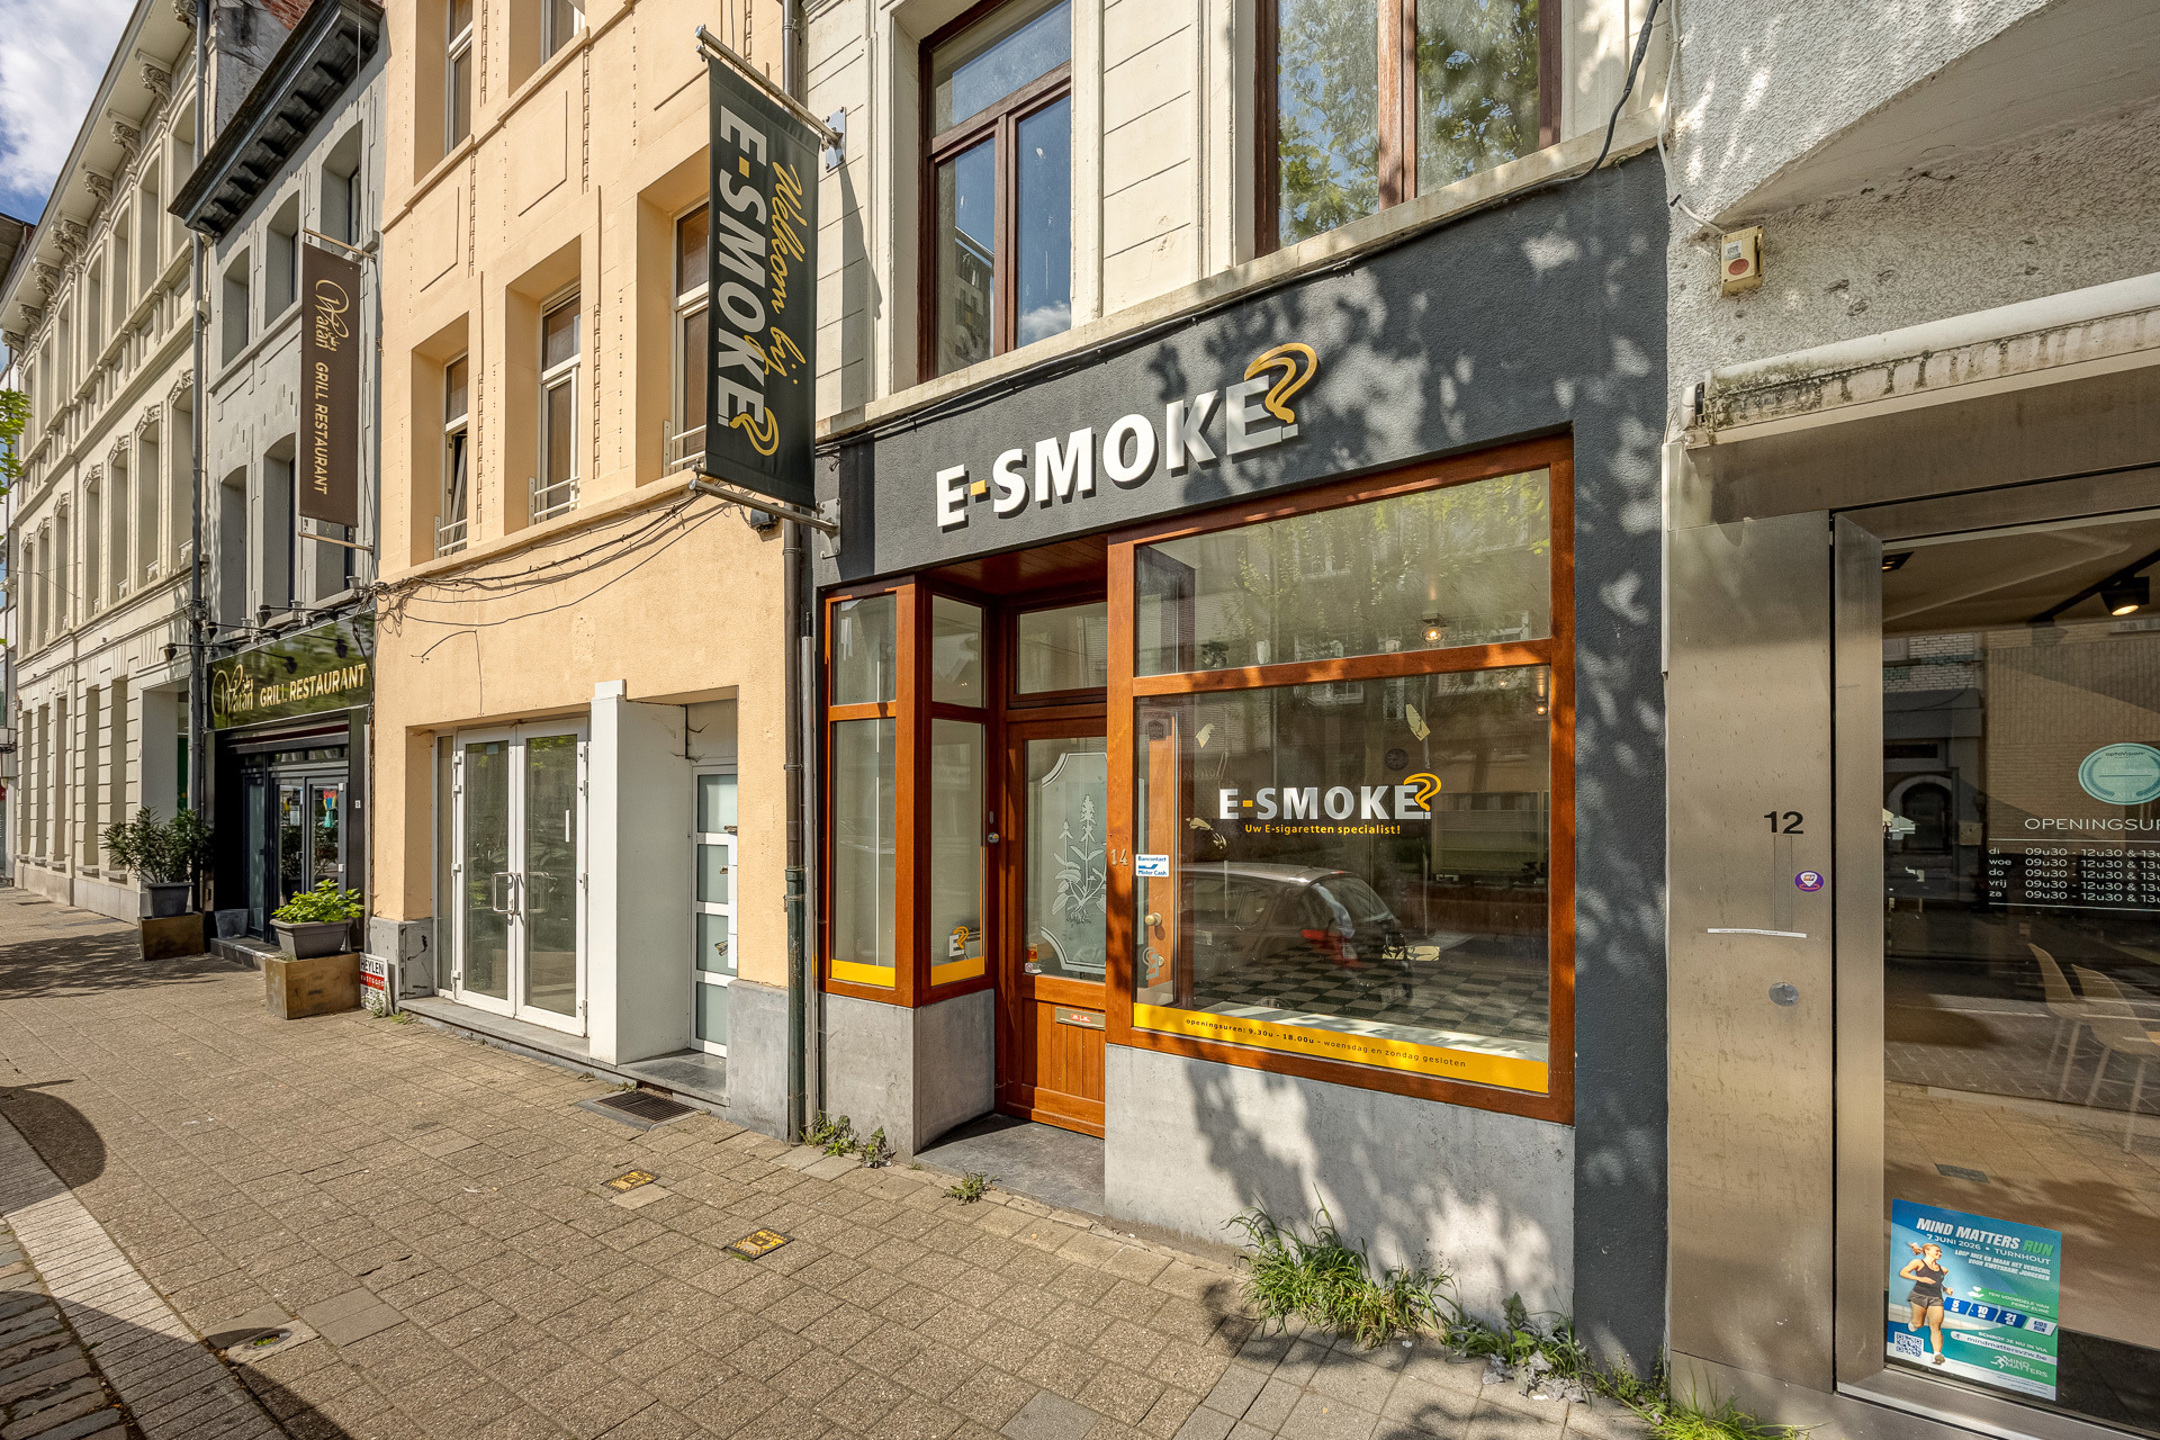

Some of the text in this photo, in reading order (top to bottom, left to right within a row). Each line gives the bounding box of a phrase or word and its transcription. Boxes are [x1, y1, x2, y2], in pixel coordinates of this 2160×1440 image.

[744, 162, 808, 384] Welkom bij
[314, 362, 329, 494] GRILL RESTAURANT
[260, 663, 367, 708] GRILL RESTAURANT
[1764, 811, 1804, 834] 12
[2025, 818, 2160, 830] OPENINGSU
[1245, 824, 1401, 836] Uw E-sigaretten specialist!
[1111, 849, 1128, 866] 14
[2025, 848, 2068, 856] 09u30
[2127, 850, 2137, 858] &
[2025, 858, 2068, 866] 09u30
[2080, 860, 2123, 868] 12u30
[2127, 861, 2137, 869] &
[2025, 869, 2068, 878] 09u30
[2080, 871, 2123, 879] 12u30
[2127, 872, 2137, 880] &
[1989, 879, 2007, 888] vrij
[2025, 880, 2068, 888] 09u30
[2080, 882, 2123, 890] 12u30
[2127, 883, 2137, 891] &
[2025, 890, 2068, 899] 09u30
[2080, 893, 2123, 901] 12u30
[2127, 894, 2137, 902] &
[360, 958, 384, 976] HEYLEN
[1186, 1018, 1247, 1034] openingsuren:
[1248, 1028, 1273, 1038] 9.30u
[1283, 1033, 1314, 1044] 18.00u
[1324, 1040, 1368, 1054] woensdag
[1385, 1050, 1419, 1062] zondag
[1422, 1054, 1466, 1068] gesloten
[1916, 1218, 2054, 1256] MIND MATTERS RUN
[1934, 1235, 1956, 1244] JUNI
[1958, 1240, 1981, 1250] 2026
[1994, 1248, 2051, 1265] TURNHOUT
[1978, 1306, 1989, 1314] 10
[2005, 1312, 2016, 1322] 21
